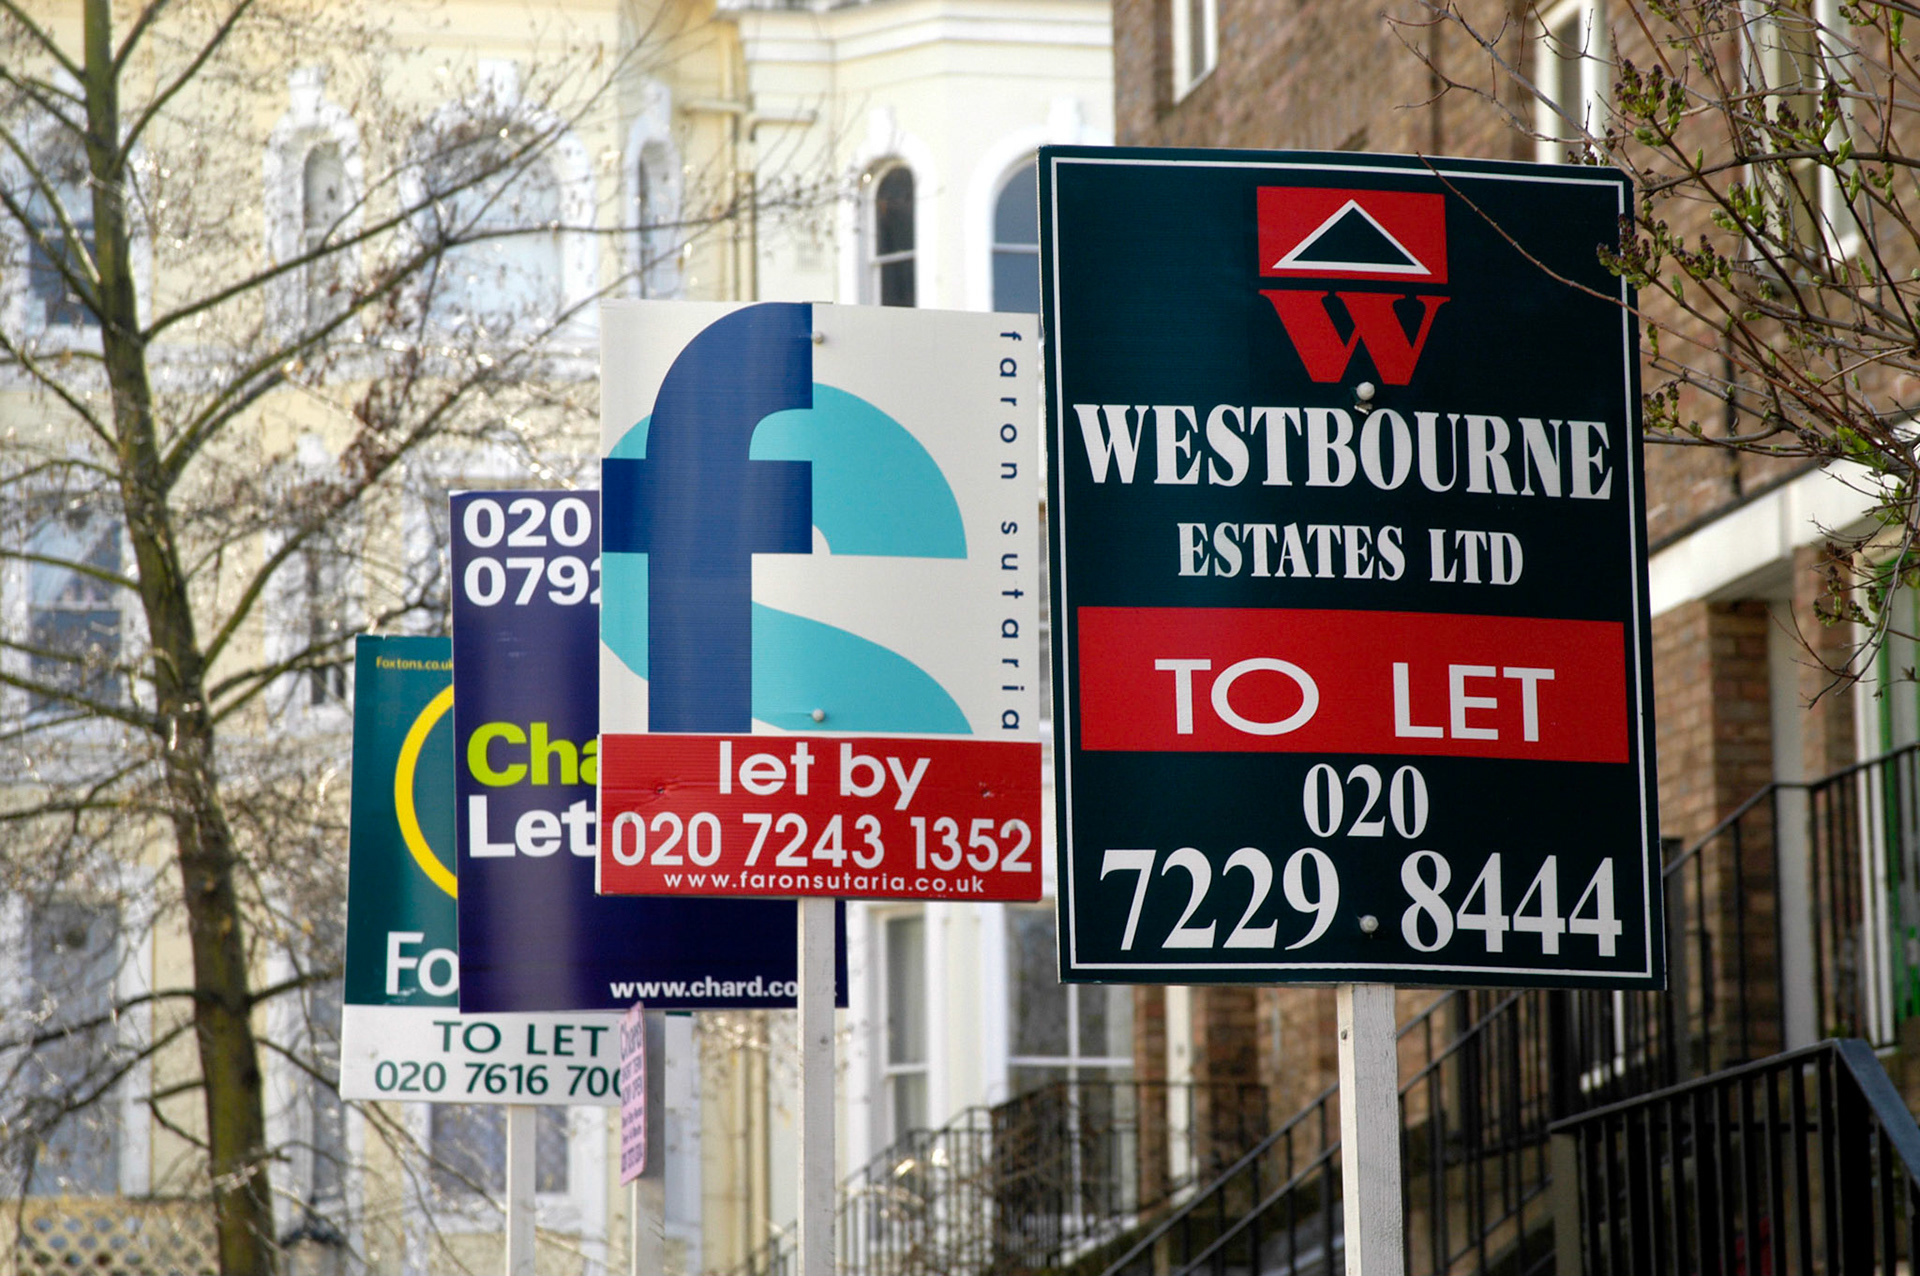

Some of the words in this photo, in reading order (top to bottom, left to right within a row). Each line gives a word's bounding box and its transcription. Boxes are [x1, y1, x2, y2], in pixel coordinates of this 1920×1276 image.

[1258, 289, 1451, 385] W
[999, 331, 1022, 479] faron
[1073, 403, 1613, 500] WESTBOURNE
[463, 497, 592, 548] 020
[1177, 522, 1406, 581] ESTATES
[1428, 528, 1524, 585] LTD
[1001, 521, 1024, 730] sutaria
[1154, 657, 1320, 735] TO
[1393, 662, 1555, 742] LET
[719, 741, 815, 795] let
[840, 742, 931, 811] by
[1303, 763, 1429, 839] 020
[612, 811, 722, 867] 020
[743, 813, 885, 869] 7243
[910, 816, 1032, 872] 1352
[663, 870, 985, 893] www.faronsutaria.co.uk
[1100, 847, 1340, 951] 7229
[1401, 850, 1623, 957] 8444
[433, 1021, 502, 1054] TO
[527, 1023, 609, 1057] LET
[375, 1061, 446, 1092] 020
[465, 1063, 549, 1096] 7616
